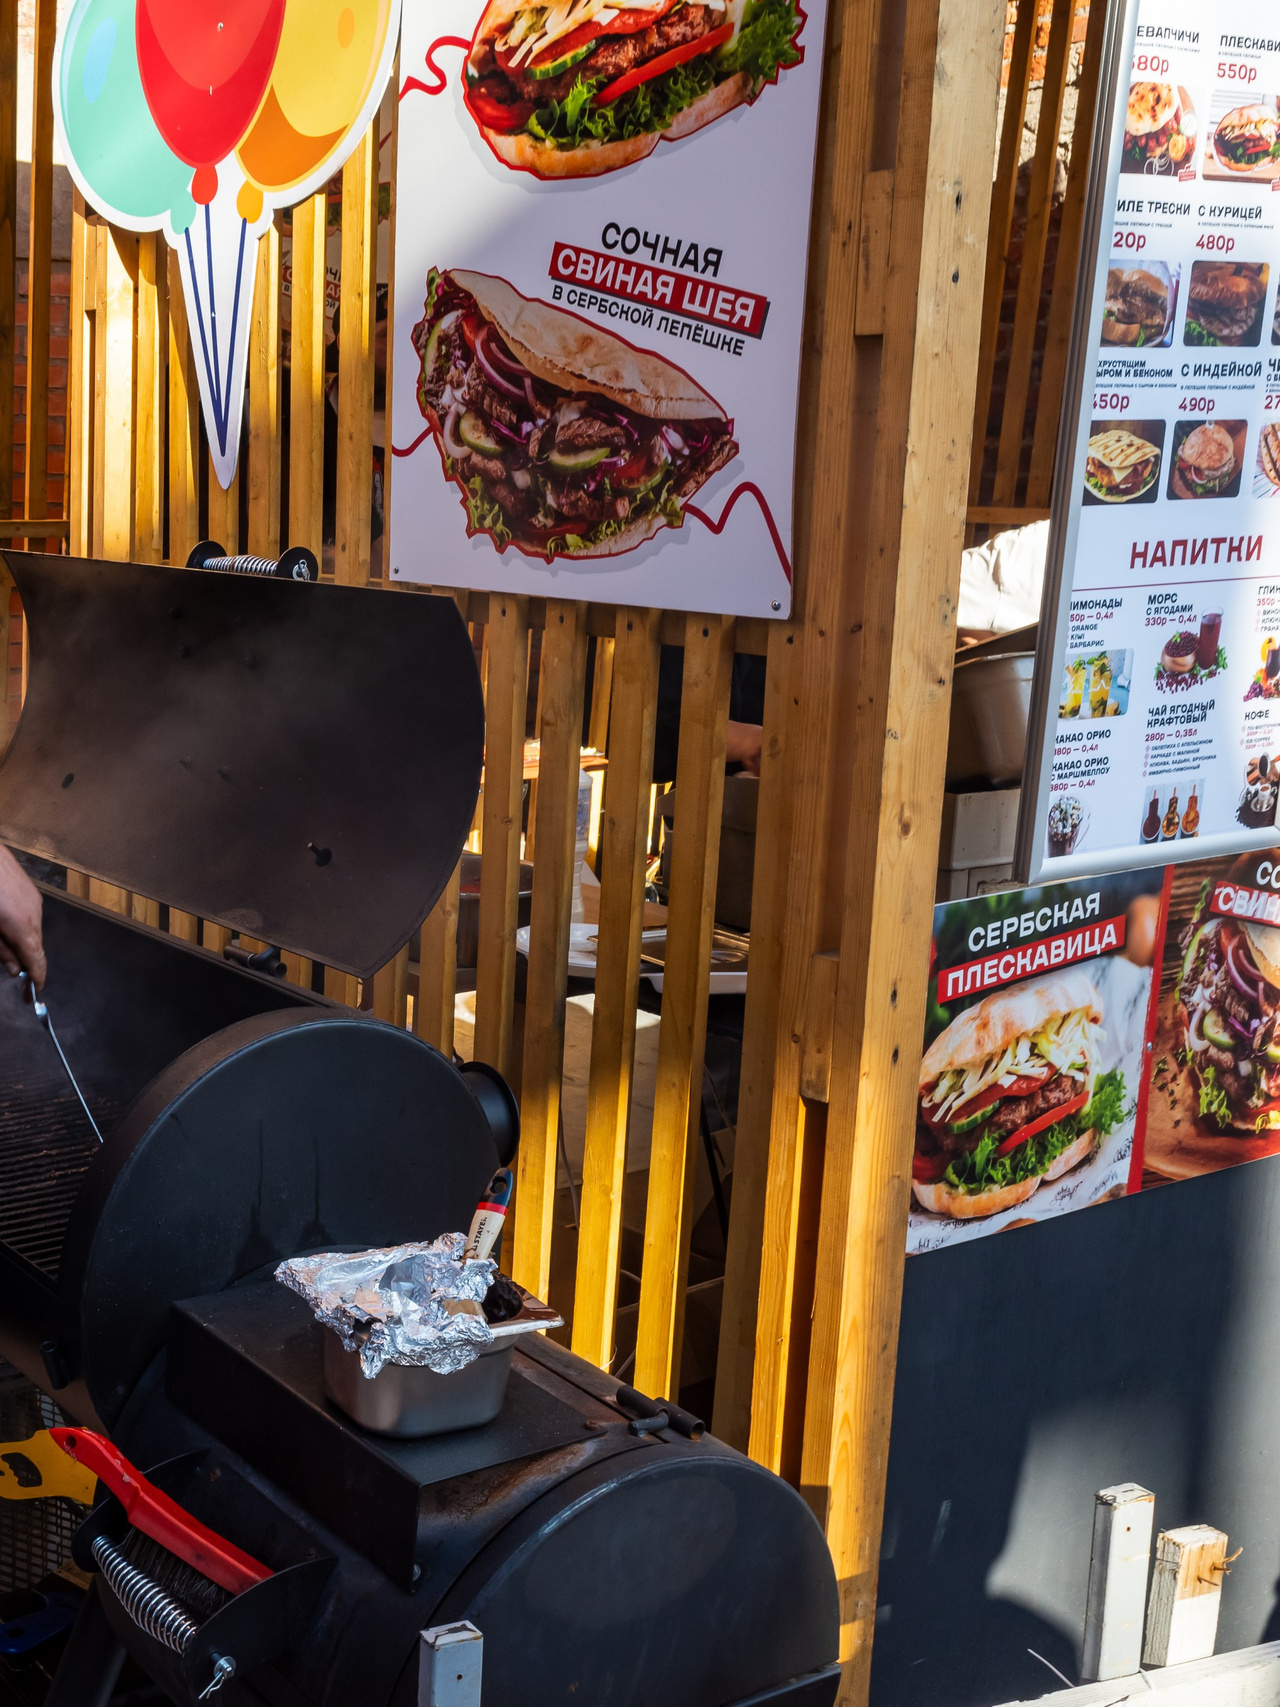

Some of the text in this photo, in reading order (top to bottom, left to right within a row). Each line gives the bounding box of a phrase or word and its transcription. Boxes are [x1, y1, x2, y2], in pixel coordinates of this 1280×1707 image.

[1217, 62, 1257, 84] 550р
[1148, 201, 1191, 215] ТРЕСКИ
[1198, 204, 1263, 221] С КУРИЦЕЙ
[601, 222, 723, 278] СОЧНАЯ
[1195, 234, 1235, 254] 480р
[556, 247, 756, 327] СВИНАЯ ШЕЯ
[552, 286, 745, 356] В СЕРБСКОЙ ЛЕПЁШКЕ
[1098, 360, 1146, 369] ХРУСТЯЩИМ
[1124, 369, 1130, 378] И
[1133, 368, 1174, 378] БЕКОНОМ
[1181, 363, 1190, 377] С
[1193, 361, 1263, 380] ИНДЕЙКОЙ
[1178, 397, 1216, 415] 490р
[1129, 534, 1264, 570] НАПИТКИ
[1147, 592, 1178, 606] МОРС
[1146, 604, 1194, 616] С ЯГОДАМИ
[1144, 614, 1198, 628] 330р 0,4л
[1070, 640, 1104, 649] БАРБАРИС
[1148, 698, 1216, 717] ЧАЙ ЯГОДНЫЙ
[1244, 709, 1270, 721] КОФЕ
[1146, 711, 1207, 728] КРАФТОВЫЙ
[1086, 728, 1112, 740] ОРИО
[1144, 728, 1198, 742] 280р 0,35л
[1084, 756, 1109, 768] ОРИО
[1056, 766, 1110, 780] МАРШМЕЛЛОУ
[967, 891, 1101, 952] СЕРБСКАЯ
[946, 922, 1117, 997] ПЛЕСКАВИЦА
